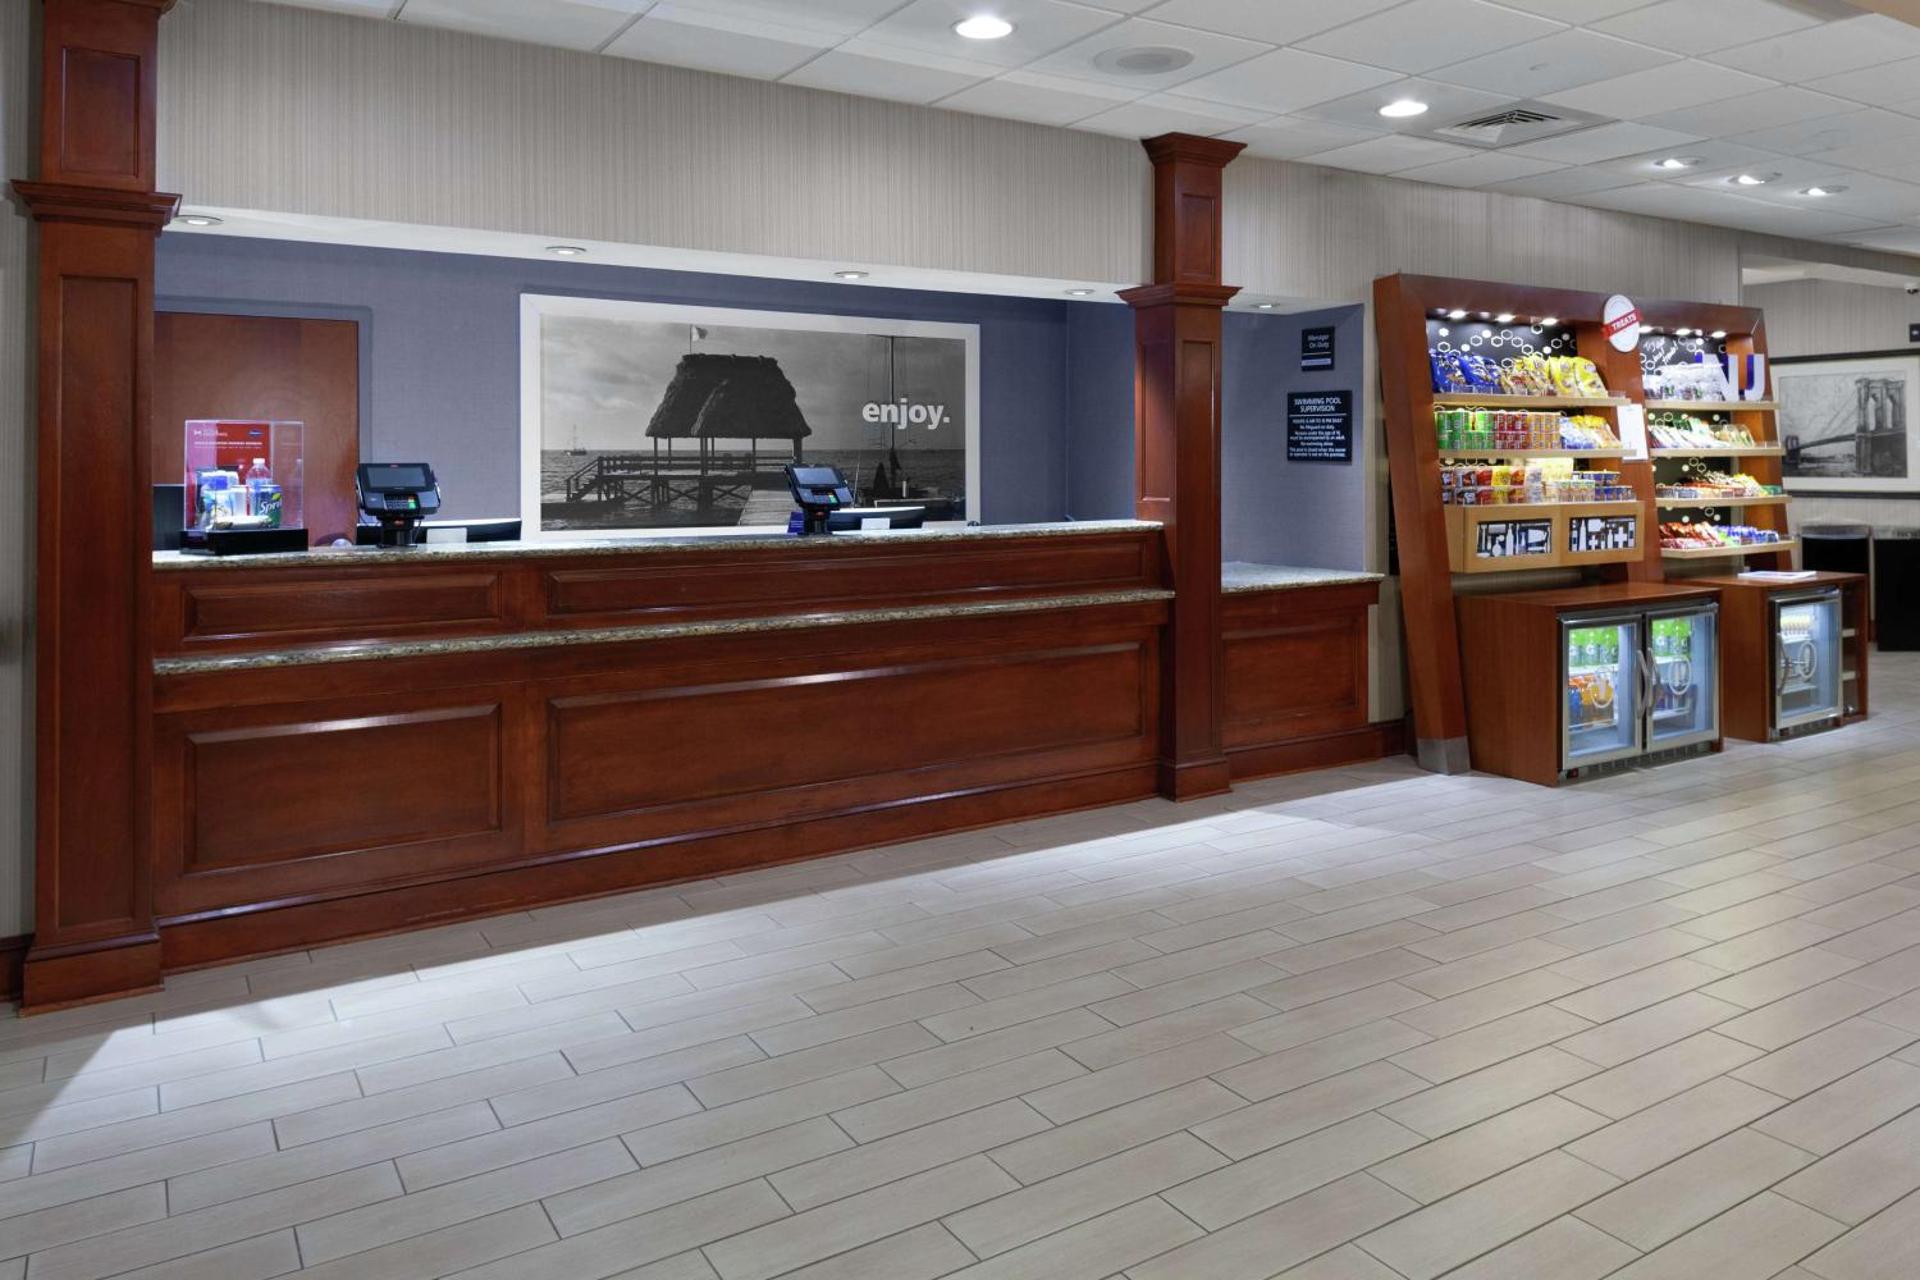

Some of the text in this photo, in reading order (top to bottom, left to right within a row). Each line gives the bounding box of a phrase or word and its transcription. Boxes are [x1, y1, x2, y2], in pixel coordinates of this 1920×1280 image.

[1611, 313, 1637, 331] TREATS
[862, 398, 950, 430] enjoy.
[1300, 405, 1335, 413] SUPERVISION
